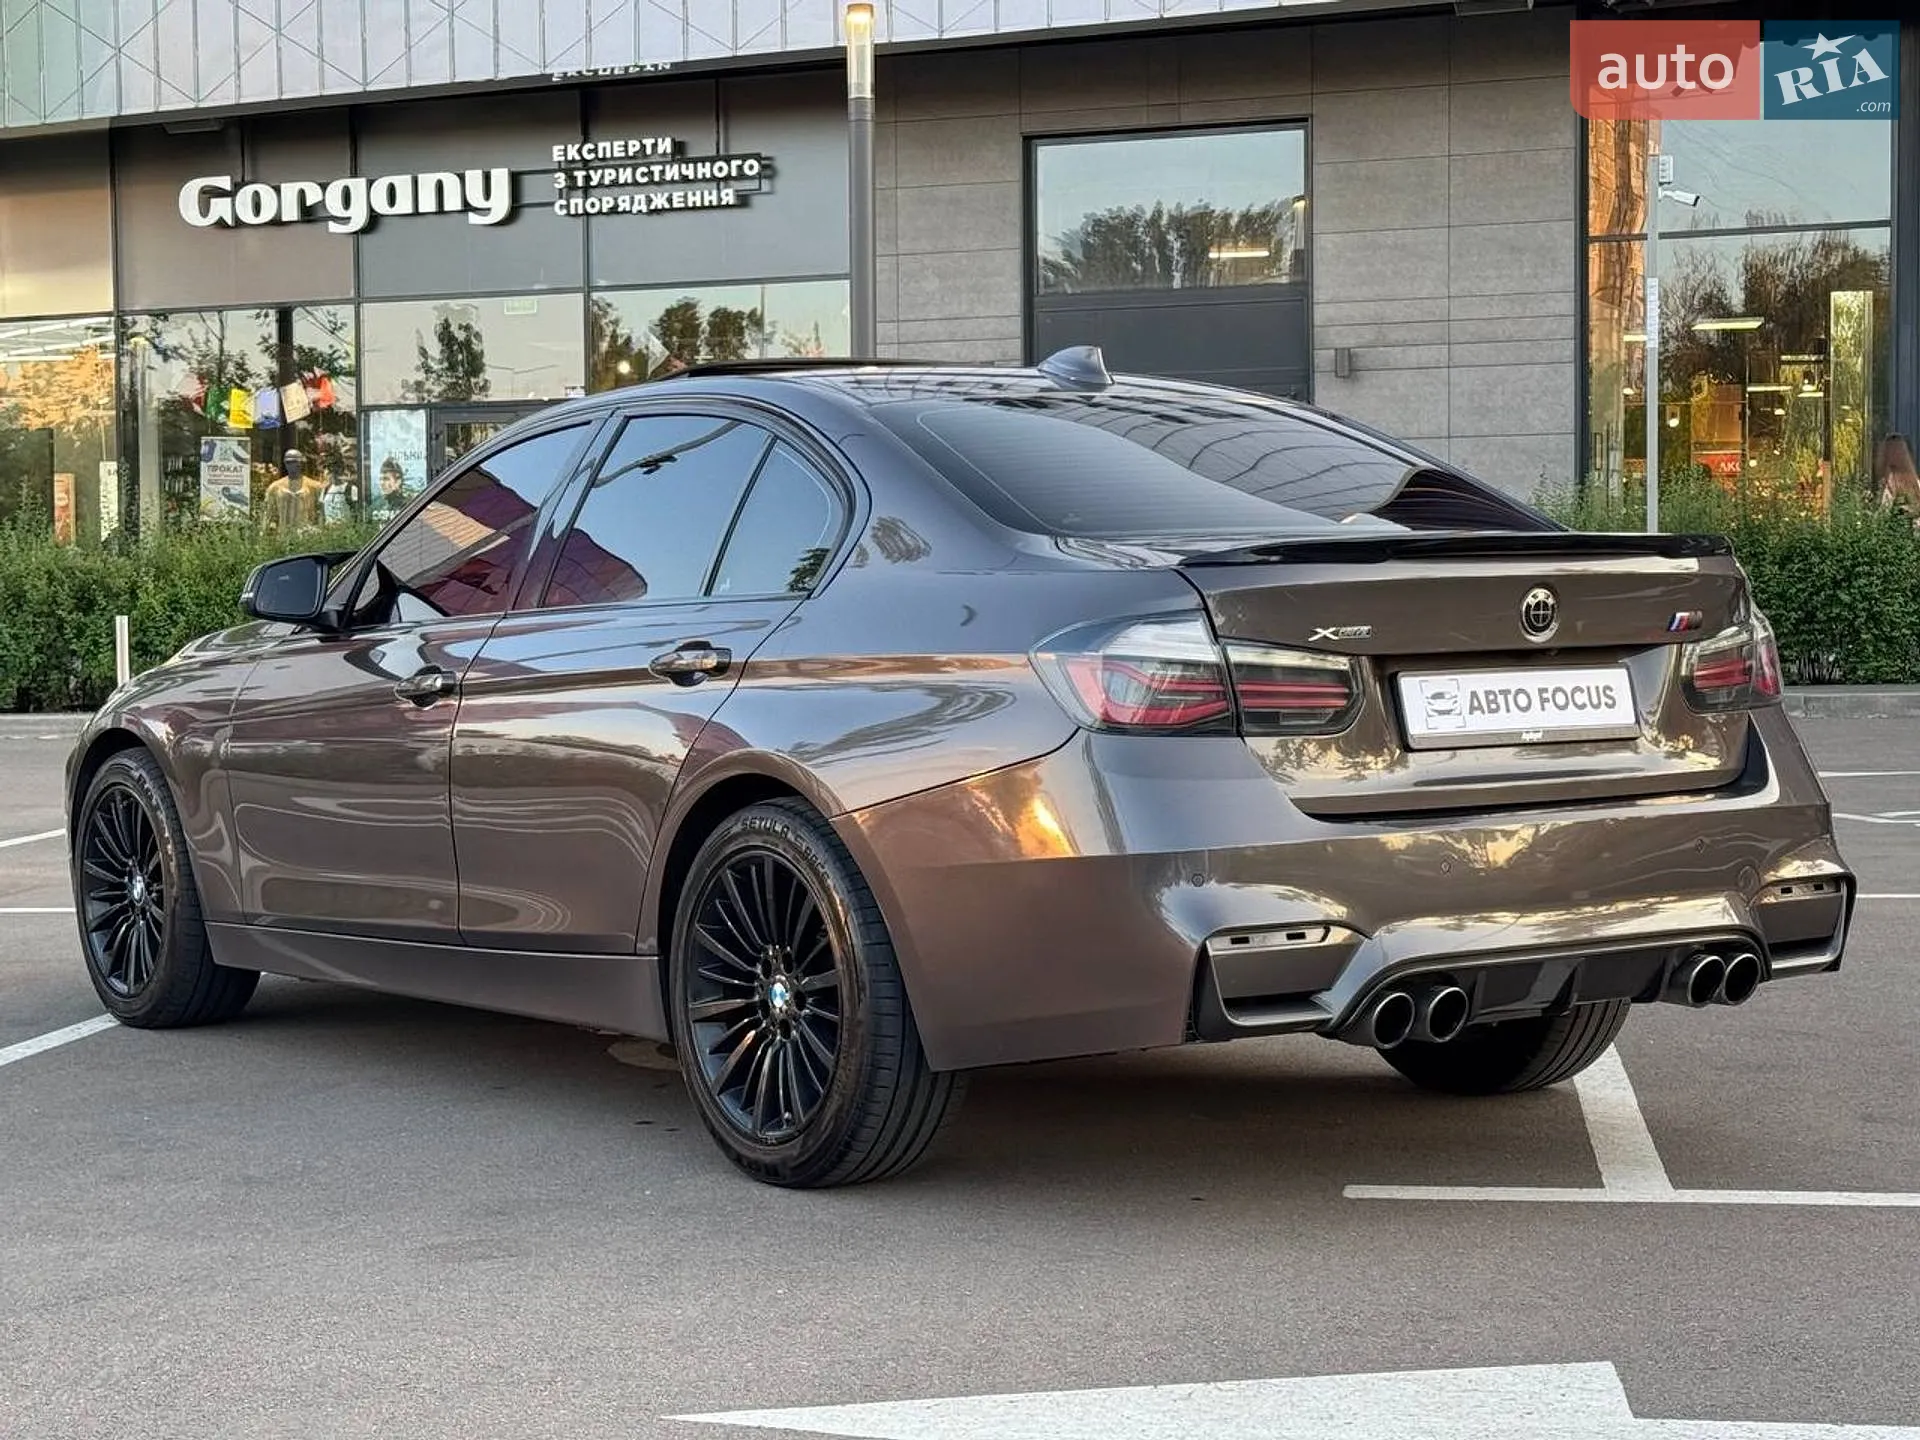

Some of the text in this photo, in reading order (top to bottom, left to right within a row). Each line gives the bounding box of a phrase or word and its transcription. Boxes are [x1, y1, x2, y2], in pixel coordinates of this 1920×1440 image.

[552, 137, 672, 162] ЕКСПЕРТИ
[573, 158, 760, 188] ТУРИСТИЧНОГО
[178, 168, 509, 234] Gorgany
[553, 187, 735, 216] СПОРЯДЖЕННЯ
[1537, 684, 1617, 711] FOCUS
